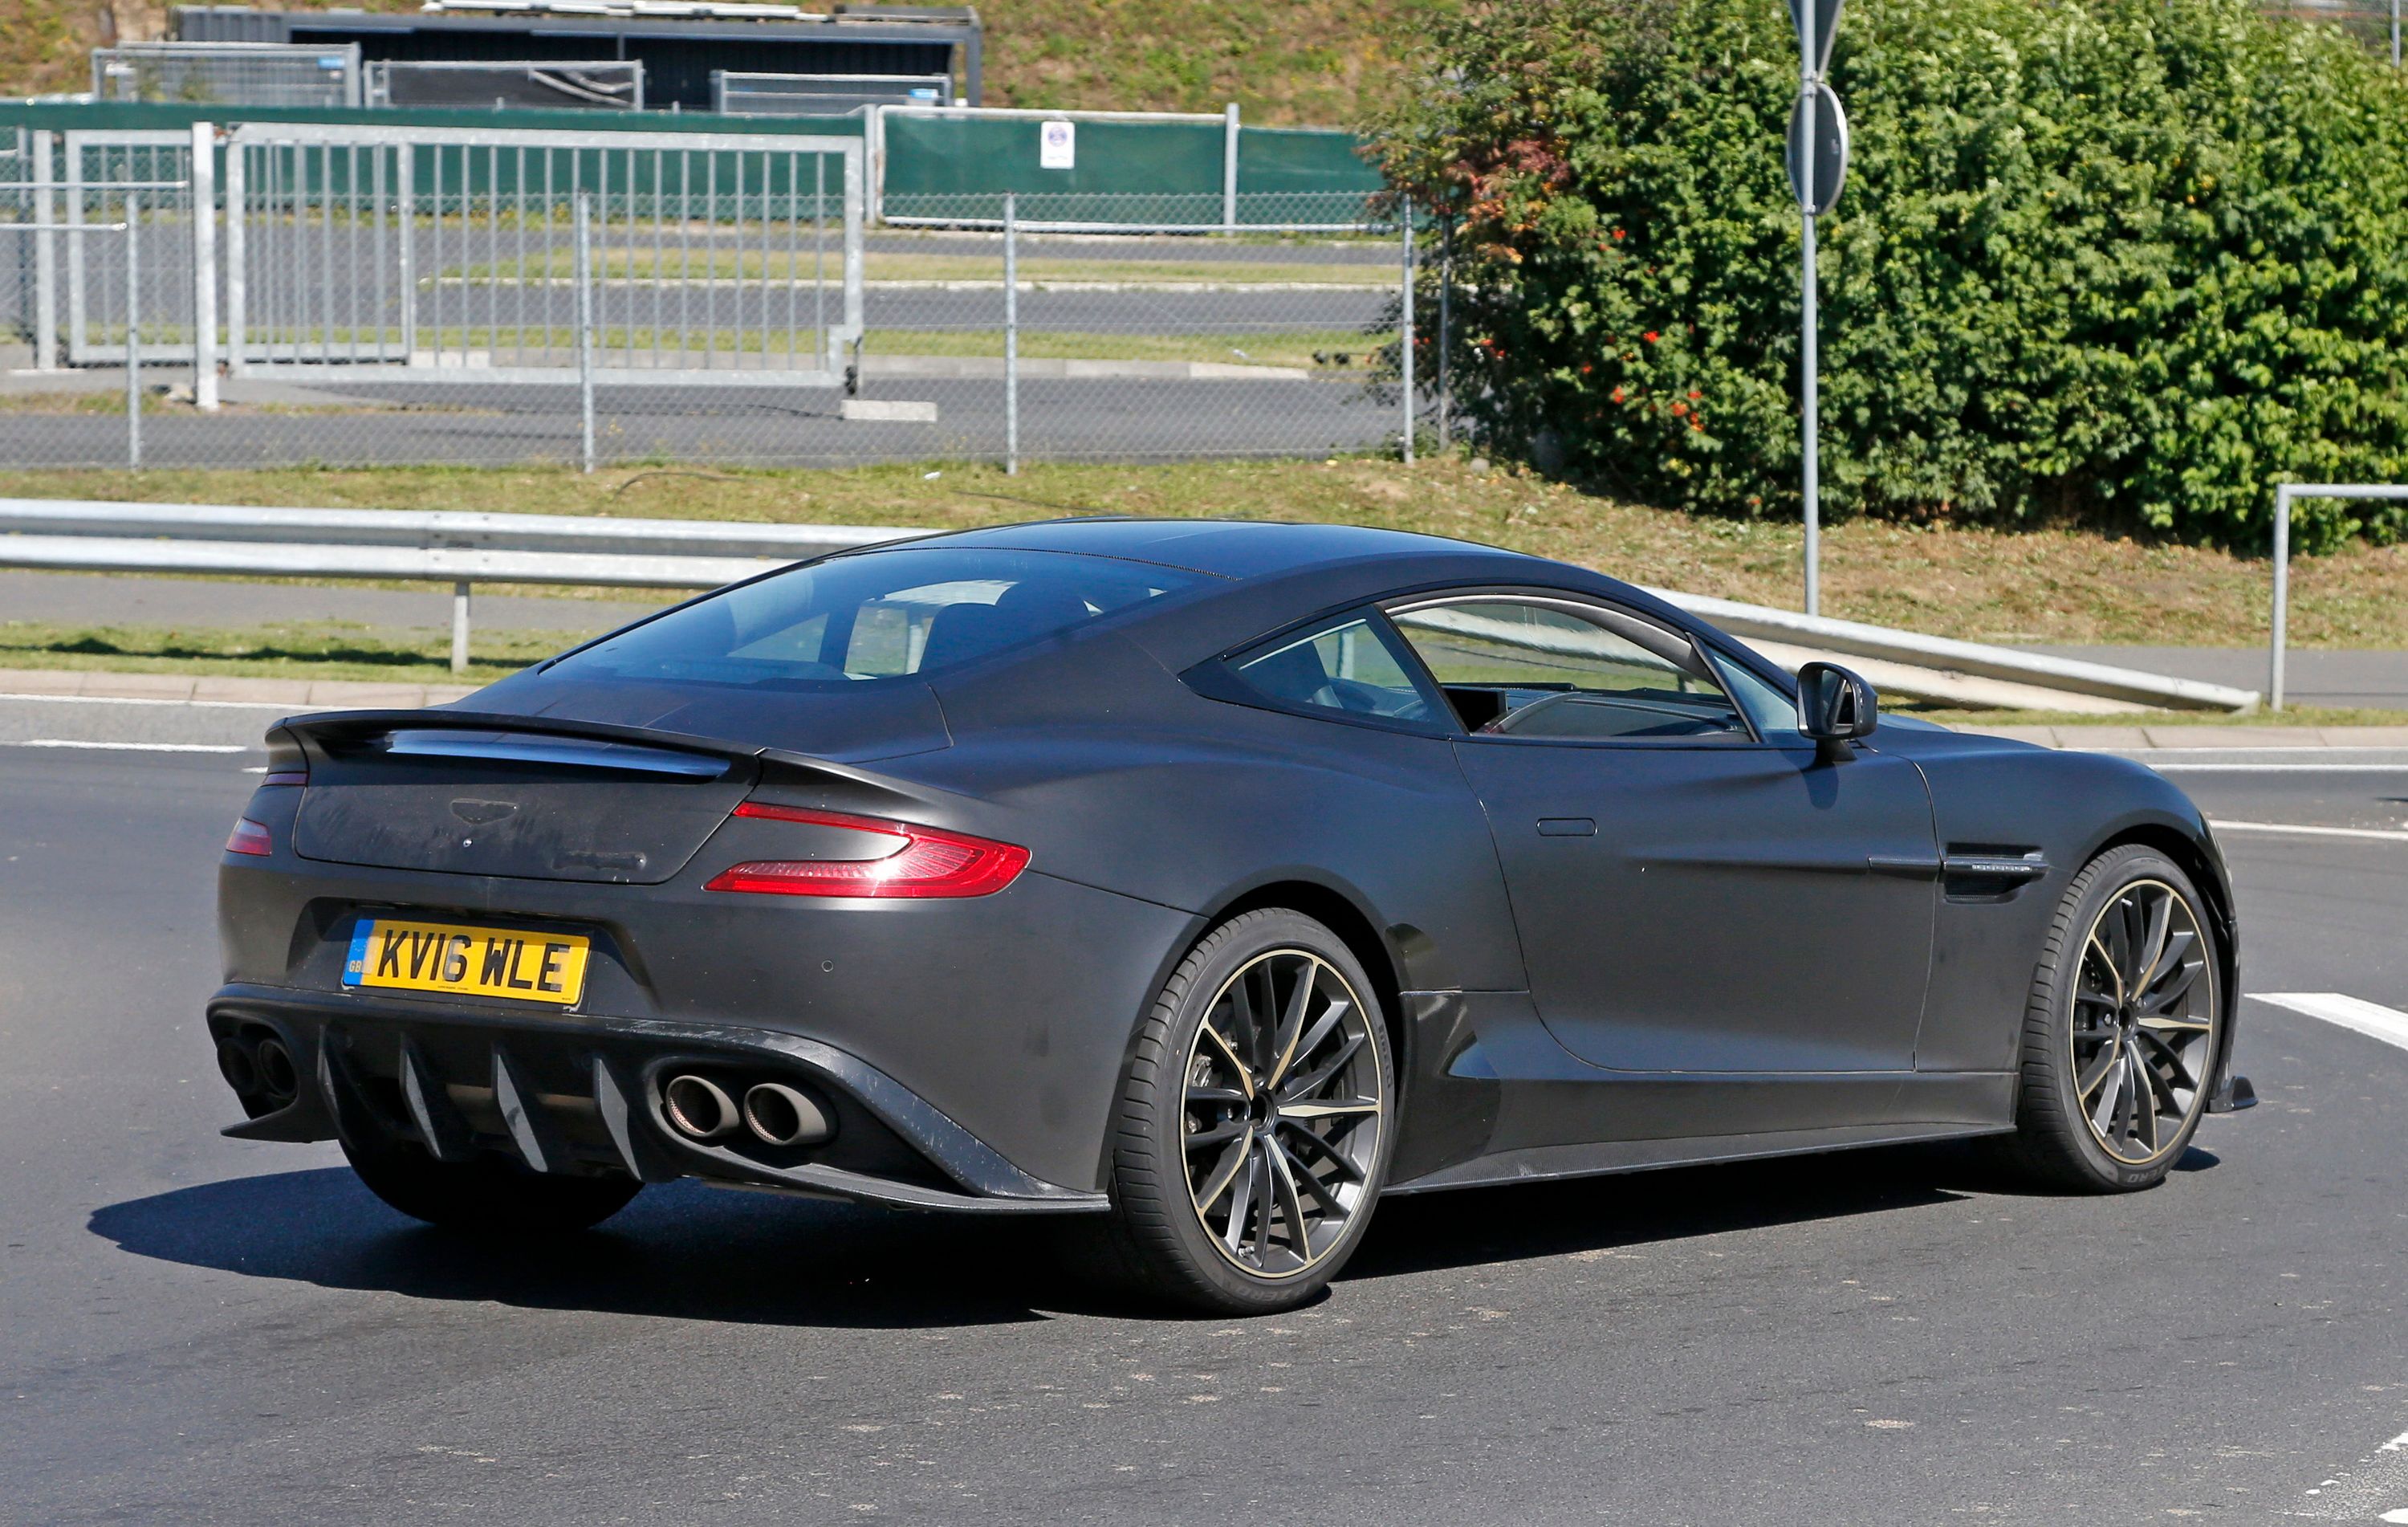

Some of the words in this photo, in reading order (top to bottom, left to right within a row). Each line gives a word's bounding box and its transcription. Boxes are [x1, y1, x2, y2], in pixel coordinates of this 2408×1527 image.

[348, 960, 362, 973] GB
[378, 929, 471, 982] KV16
[480, 937, 570, 992] WLE
